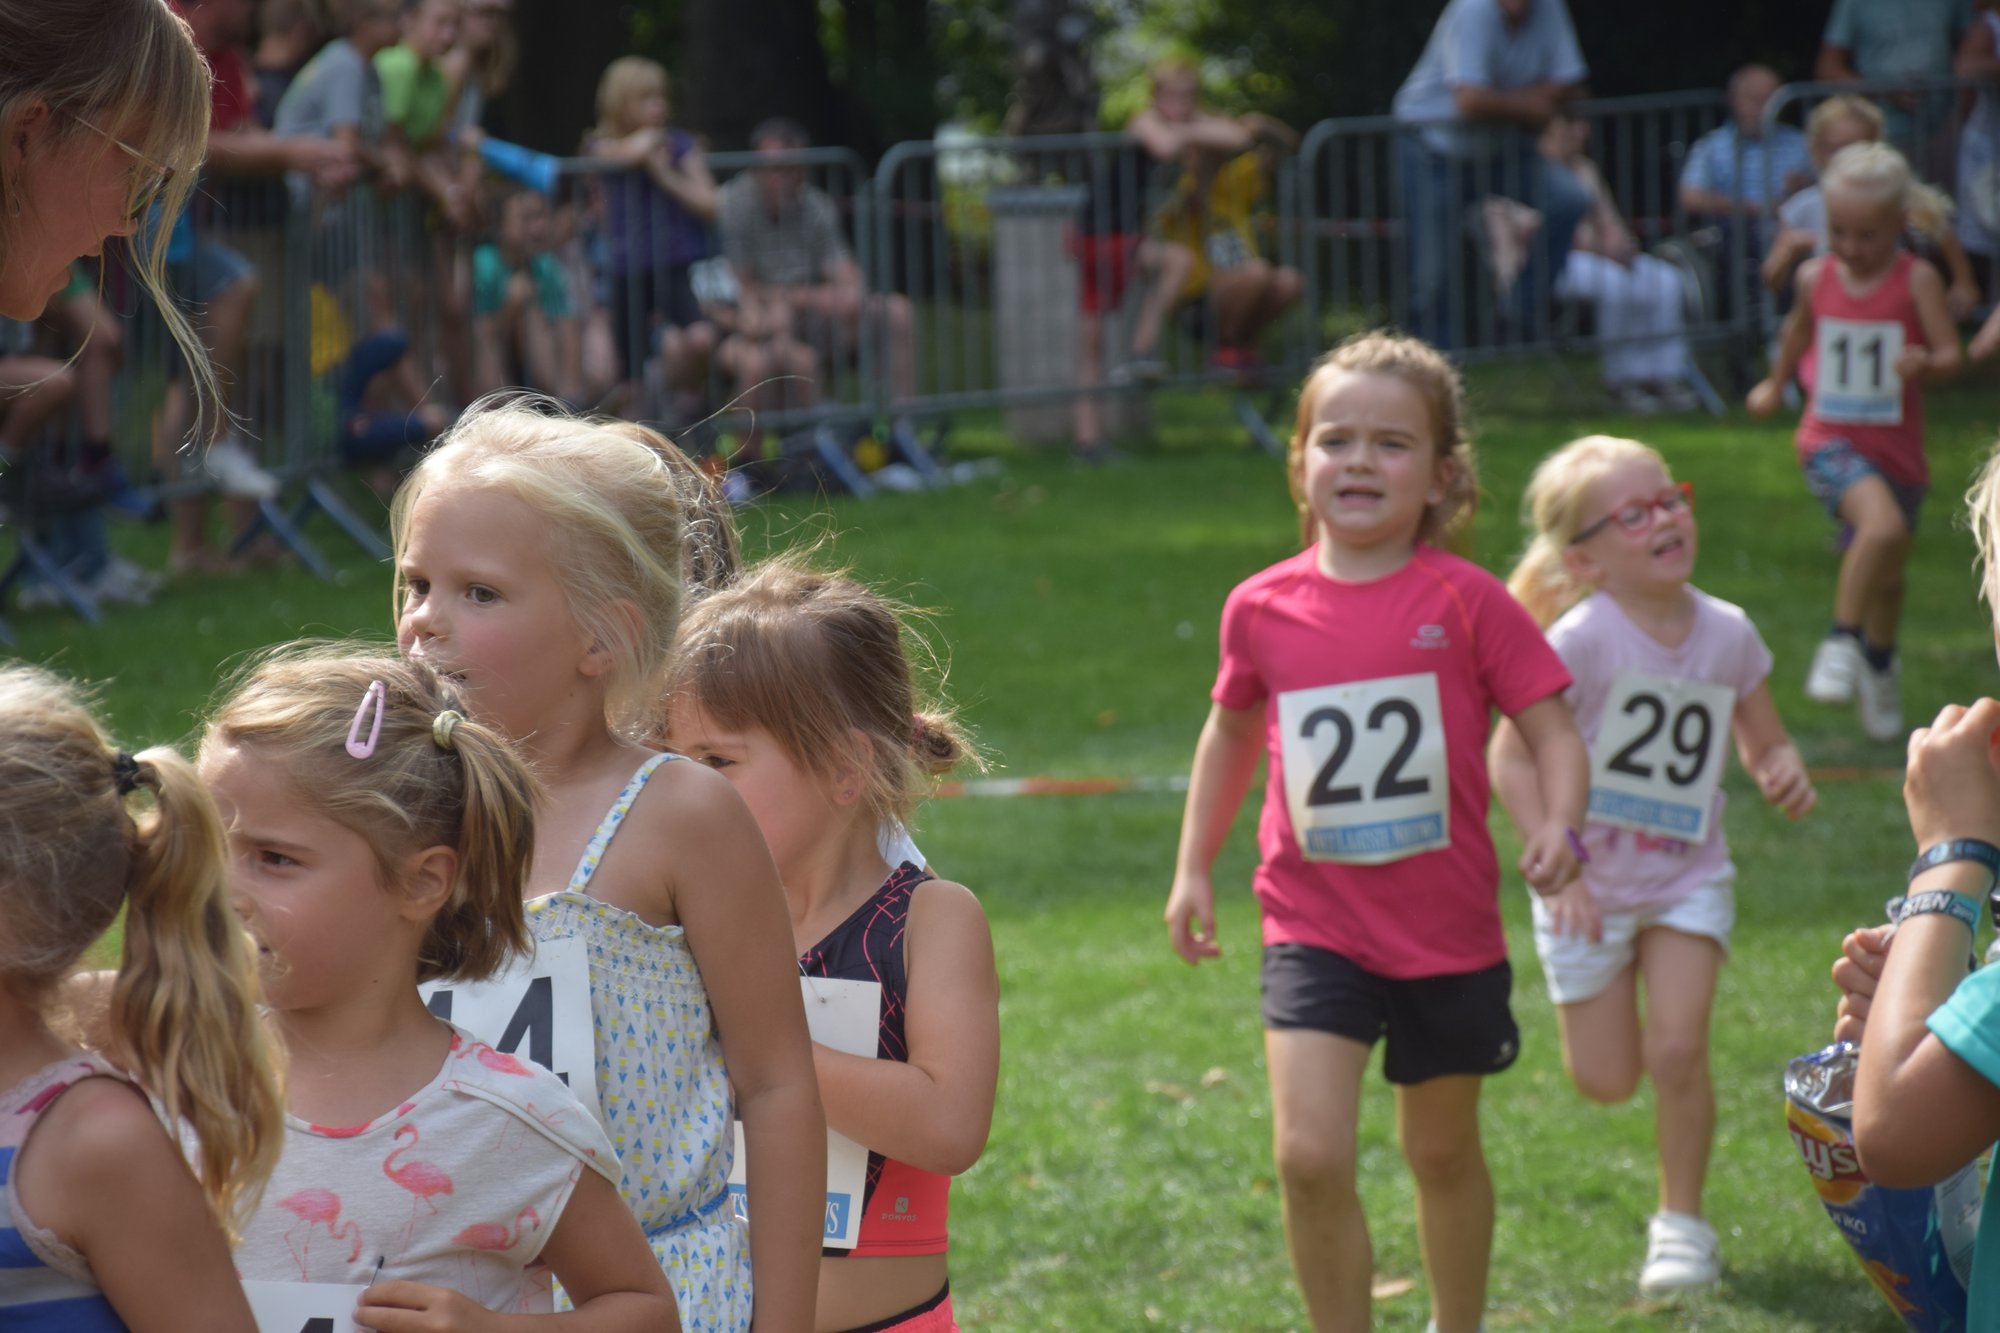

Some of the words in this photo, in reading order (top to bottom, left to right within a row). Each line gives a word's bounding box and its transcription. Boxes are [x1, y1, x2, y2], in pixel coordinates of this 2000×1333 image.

[1829, 333, 1884, 388] 11
[1299, 697, 1431, 807] 22
[1605, 691, 1713, 787] 29
